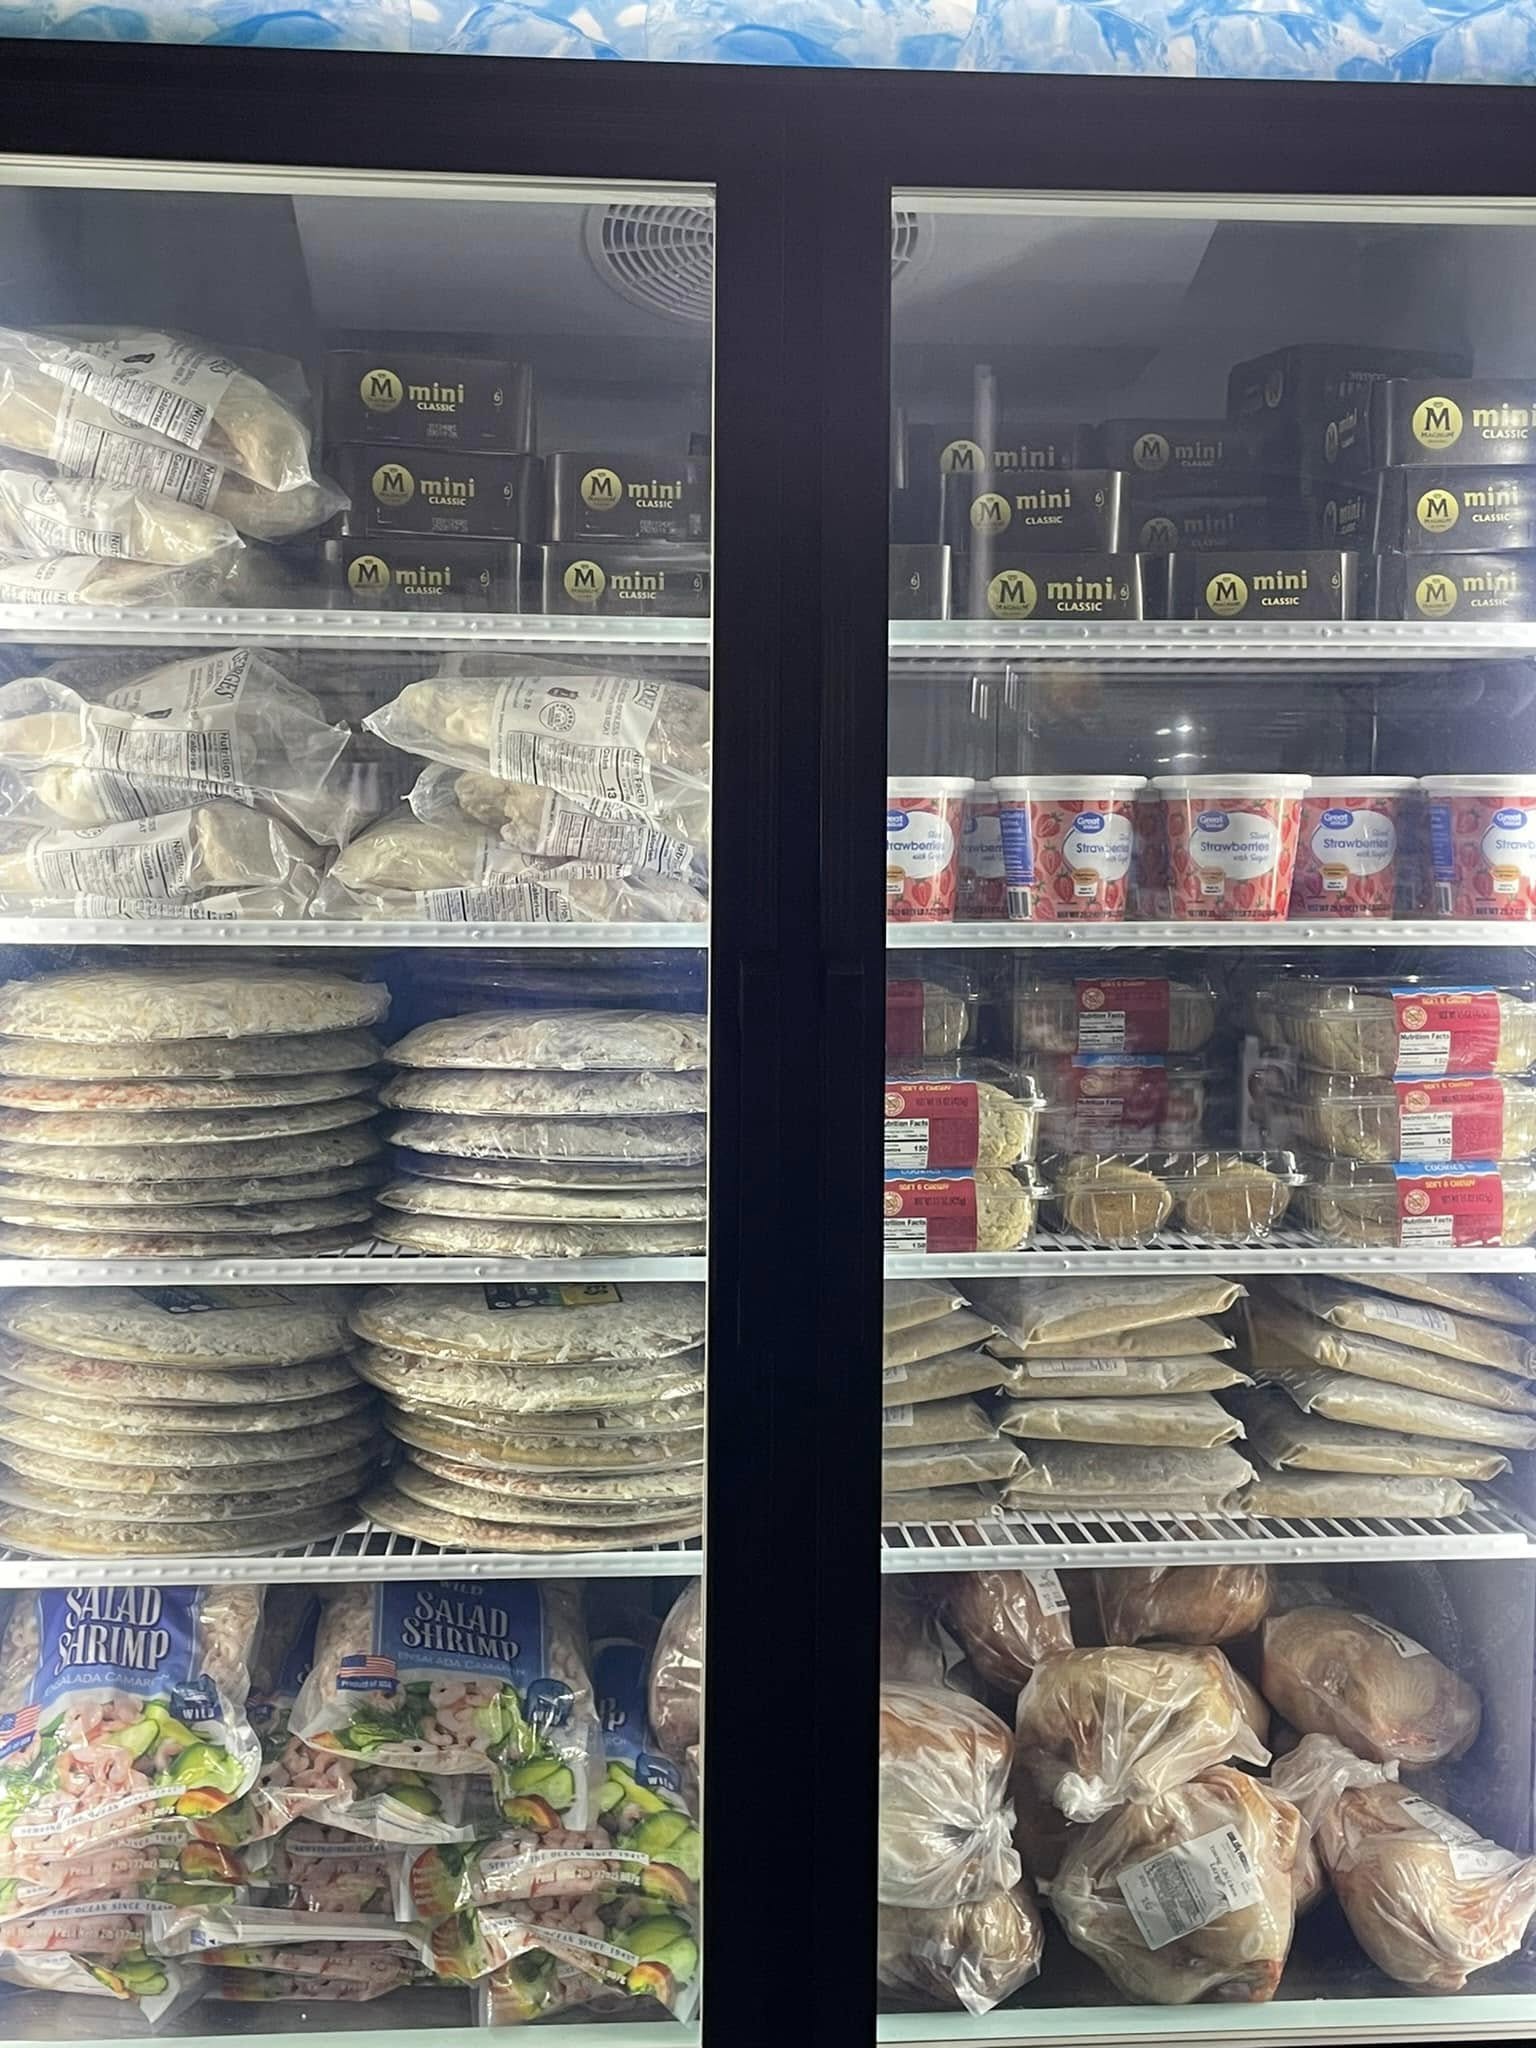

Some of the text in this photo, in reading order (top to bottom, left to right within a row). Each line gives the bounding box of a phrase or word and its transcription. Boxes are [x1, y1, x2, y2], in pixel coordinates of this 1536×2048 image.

[371, 376, 392, 398] M
[408, 382, 464, 403] mini
[416, 402, 456, 412] CLASSIC
[1472, 403, 1536, 427] mini
[1425, 407, 1450, 431] M
[1482, 429, 1528, 439] CLASSIC
[993, 446, 1055, 467] mini
[1142, 440, 1160, 458] M
[1175, 441, 1223, 459] mini
[951, 450, 974, 470] M
[383, 472, 404, 492] M
[421, 476, 475, 497] mini
[591, 477, 612, 496] M
[628, 480, 682, 499] mini
[428, 497, 467, 506] CLASSIC
[636, 499, 672, 509] CLASSIC
[1016, 488, 1071, 509] mini
[1463, 486, 1518, 507] mini
[979, 502, 1001, 521] M
[1427, 498, 1448, 517] M
[1025, 516, 1063, 525] CLASSIC
[1472, 514, 1510, 522] CLASSIC
[358, 563, 380, 583] M
[396, 566, 450, 585] mini
[574, 568, 595, 588] M
[611, 571, 665, 590] mini
[1253, 570, 1308, 590] mini
[1463, 572, 1517, 591] mini
[404, 586, 443, 595] CLASSIC
[619, 591, 656, 599] CLASSIC
[1000, 579, 1025, 603] M
[1048, 576, 1112, 600] mini
[1216, 582, 1238, 601] M
[1425, 583, 1447, 602] M
[1057, 601, 1103, 612] CLASSIC
[1261, 597, 1300, 606] CLASSIC
[1470, 599, 1509, 608] CLASSIC
[219, 733, 232, 779] Nutrition
[1077, 817, 1100, 825] Great
[1496, 813, 1521, 821] Great
[1200, 841, 1269, 852] Strawberries
[1323, 838, 1389, 849] Strawberries
[65, 1586, 162, 1631] SALAD
[415, 1591, 508, 1638] SALAD
[402, 1615, 519, 1662] SHRIMP
[54, 1624, 170, 1677] SHRIMP
[183, 1709, 215, 1720] WILD
[112, 1902, 139, 1911] SINCE
